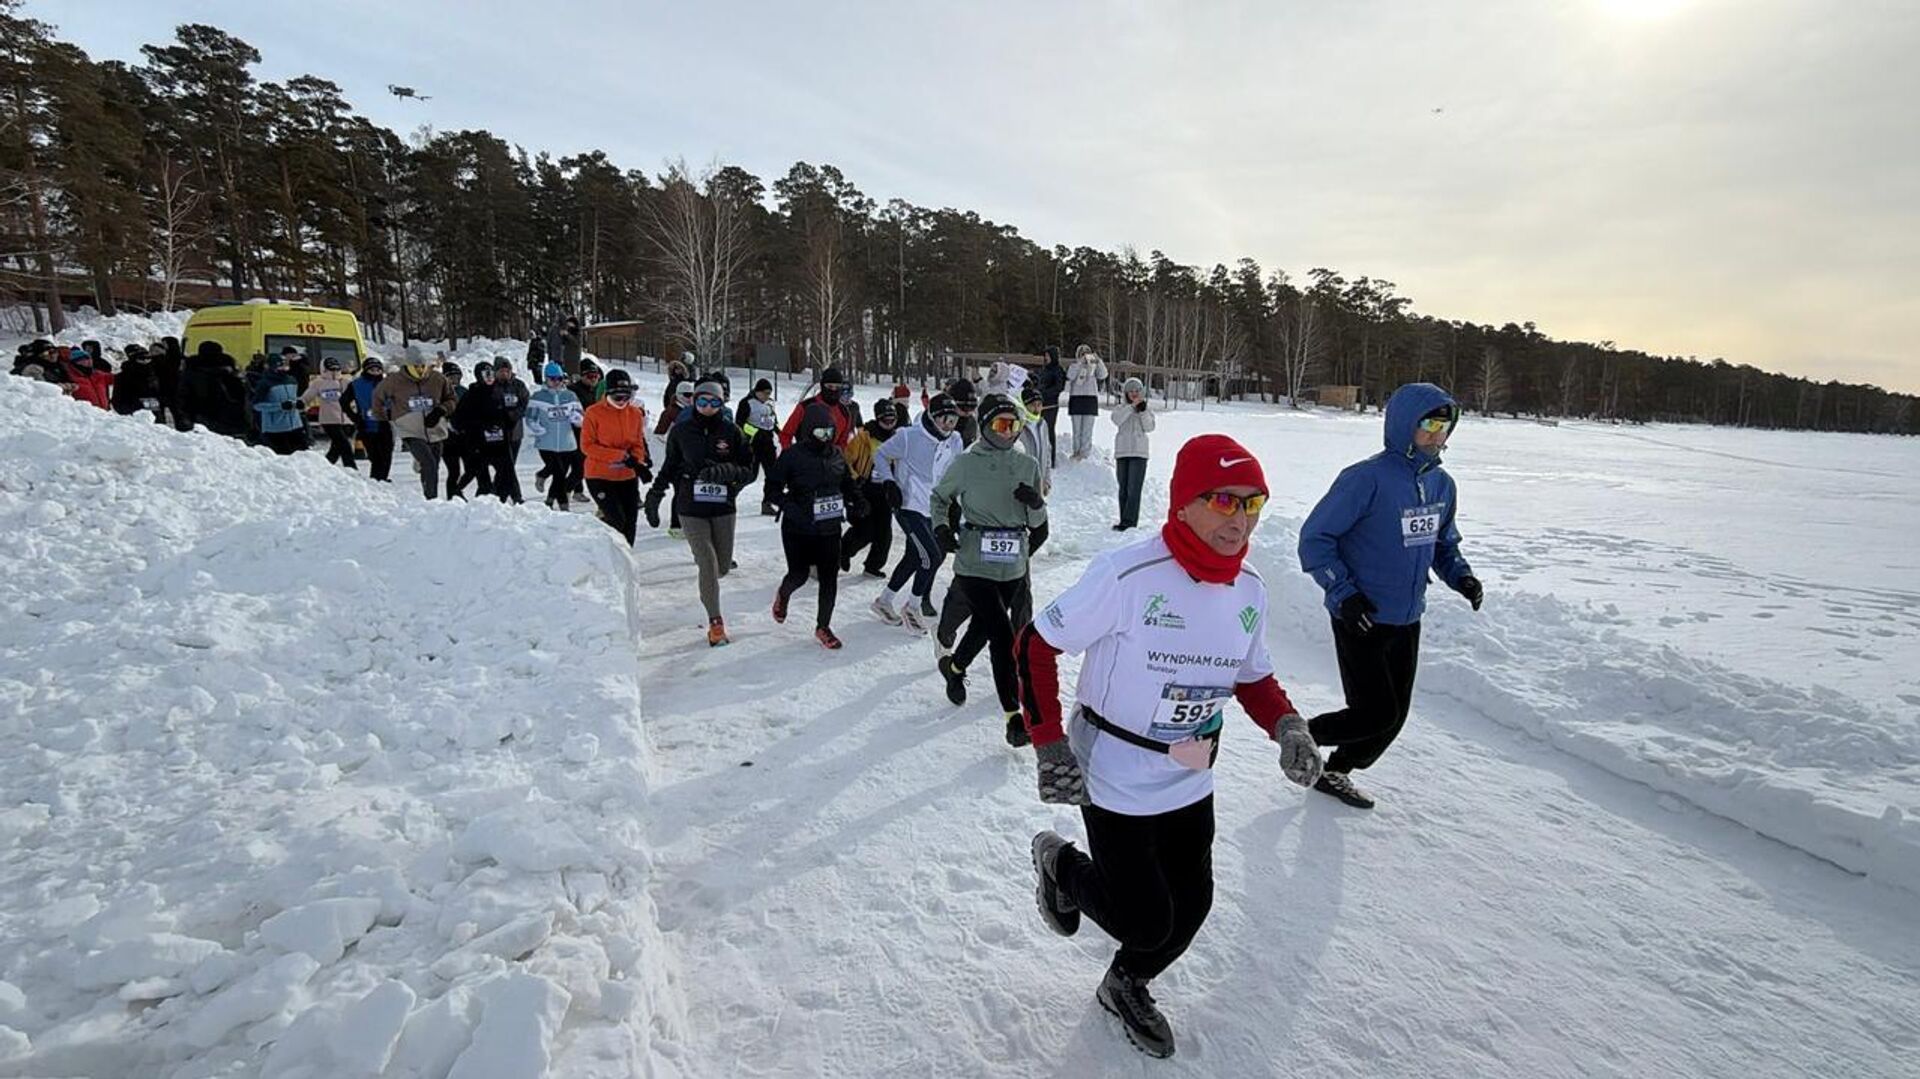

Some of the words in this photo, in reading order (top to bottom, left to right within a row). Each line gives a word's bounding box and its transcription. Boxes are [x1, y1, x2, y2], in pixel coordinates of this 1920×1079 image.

[296, 323, 326, 334] 103
[700, 486, 721, 496] 489
[1410, 517, 1434, 533] 626
[990, 540, 1014, 552] 597
[1147, 650, 1212, 666] WYNDHAM
[1170, 701, 1217, 723] 593
